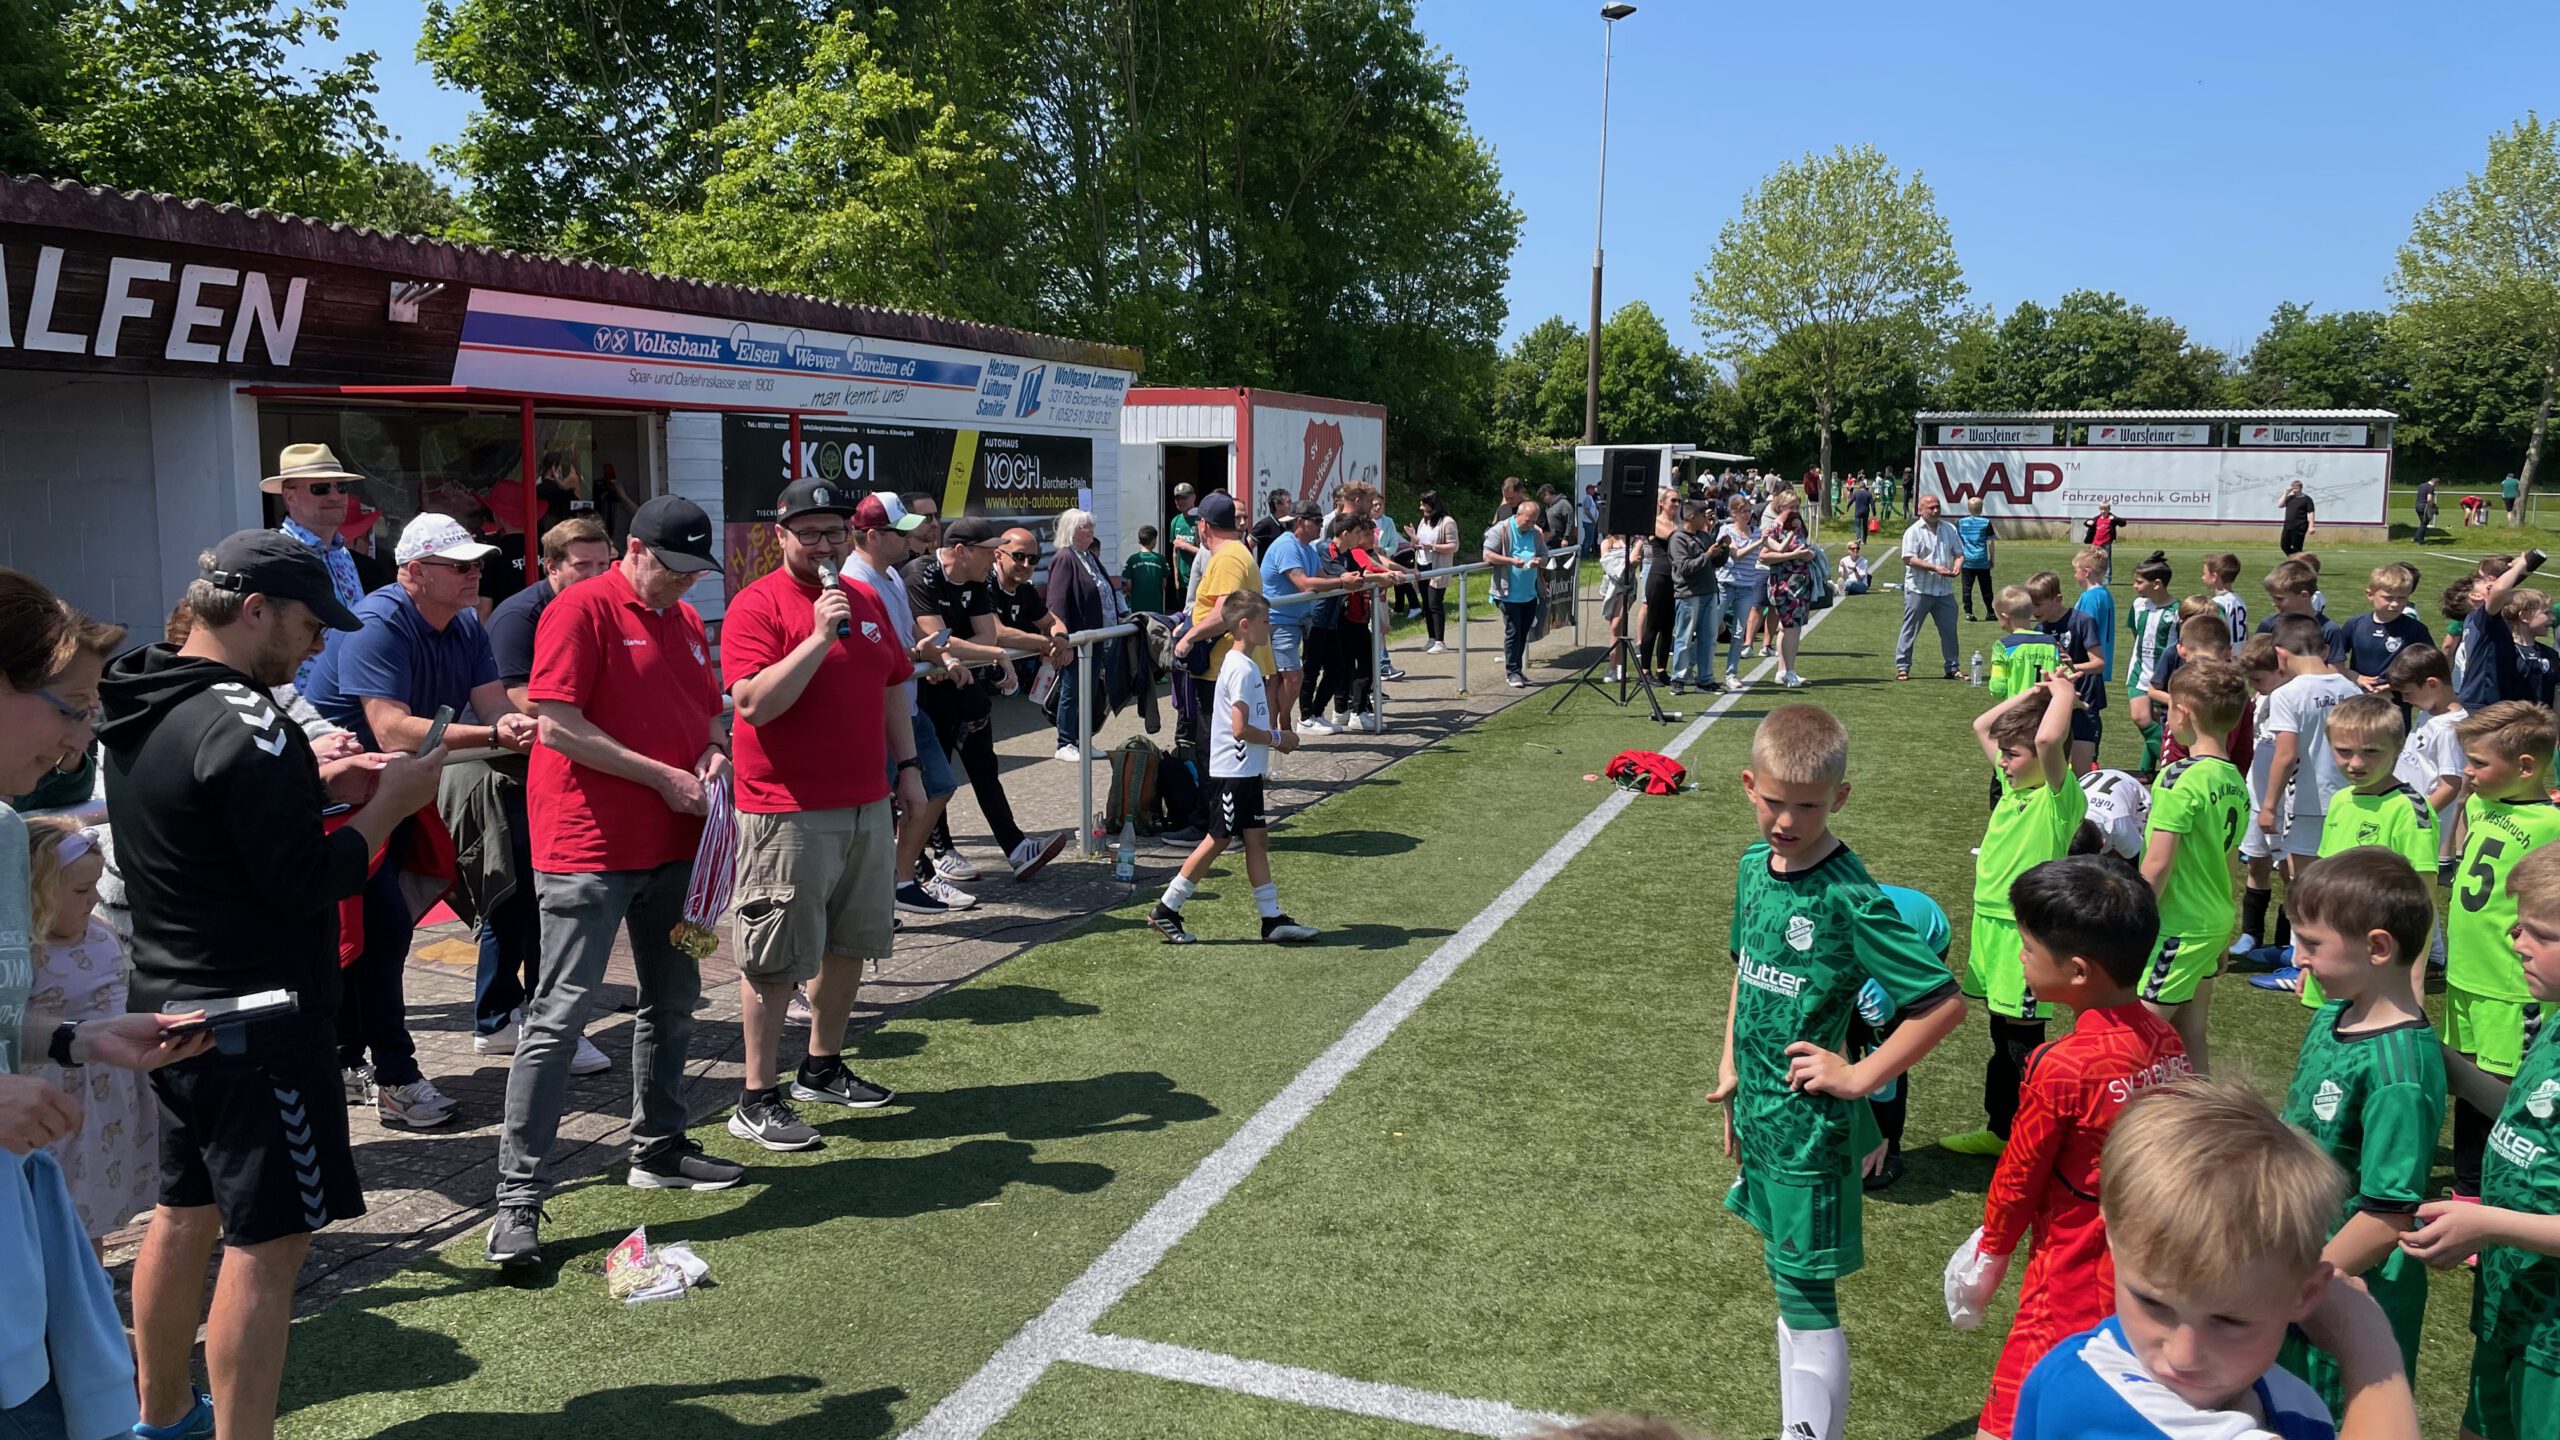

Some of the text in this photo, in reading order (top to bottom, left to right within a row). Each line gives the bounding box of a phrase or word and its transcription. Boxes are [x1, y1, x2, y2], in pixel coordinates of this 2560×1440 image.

[0, 243, 308, 366] LFEN
[632, 330, 917, 377] Volksbank Elsen Wewer Borchen eG
[627, 367, 775, 392] Spar- und Darlehnskasse seit 1903
[986, 358, 1020, 380] Heizung
[1054, 366, 1125, 391] Wolfgang Lammers
[810, 390, 841, 407] man
[844, 385, 880, 406] kennt
[882, 384, 909, 402] uns!
[981, 379, 1012, 399] Lüftung
[1073, 391, 1120, 408] Borchen-Alfen
[976, 398, 1006, 417] Sanitär
[984, 438, 1019, 449] AUTOHAUS
[1968, 427, 2022, 443] Warsteiner
[2119, 427, 2176, 443] Warsteiner
[2273, 427, 2331, 443] Warsteiner
[984, 452, 1040, 490] KOCH
[1934, 462, 2081, 504] WAP TM
[2062, 490, 2211, 505] Fahrzeugtechnik GmbH
[2229, 606, 2247, 643] 13
[2314, 695, 2336, 709] TuRa
[2108, 1075, 2134, 1103] SV
[2152, 1054, 2192, 1085] BÜRE
